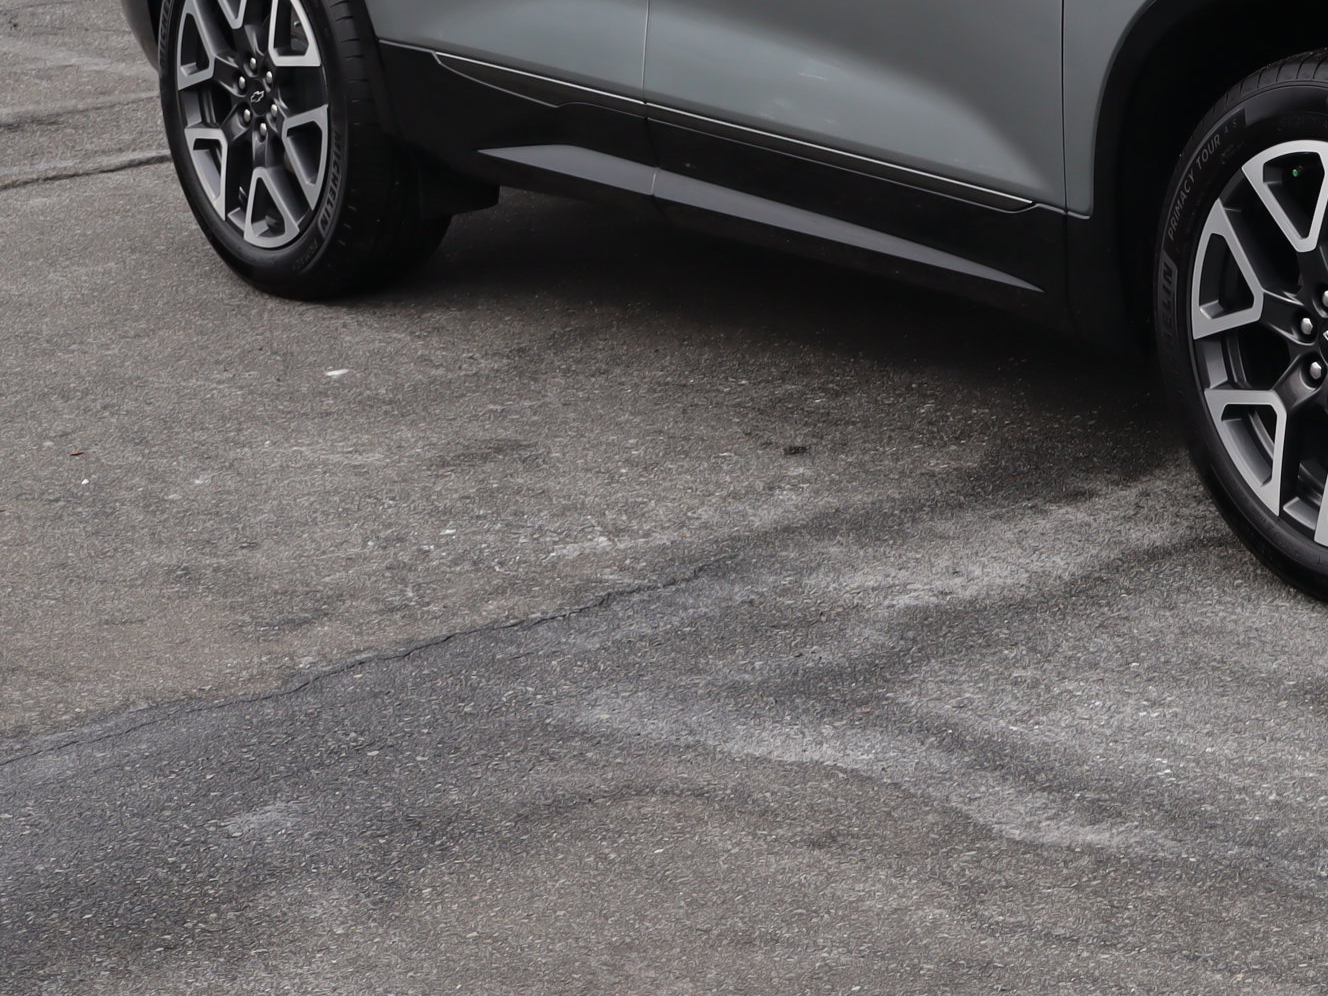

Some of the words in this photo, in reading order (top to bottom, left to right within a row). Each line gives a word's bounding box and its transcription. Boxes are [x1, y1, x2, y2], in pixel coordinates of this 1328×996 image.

[321, 129, 343, 231] MICHELIN
[1167, 172, 1196, 243] PRIMACY
[1194, 132, 1222, 172] TOUR
